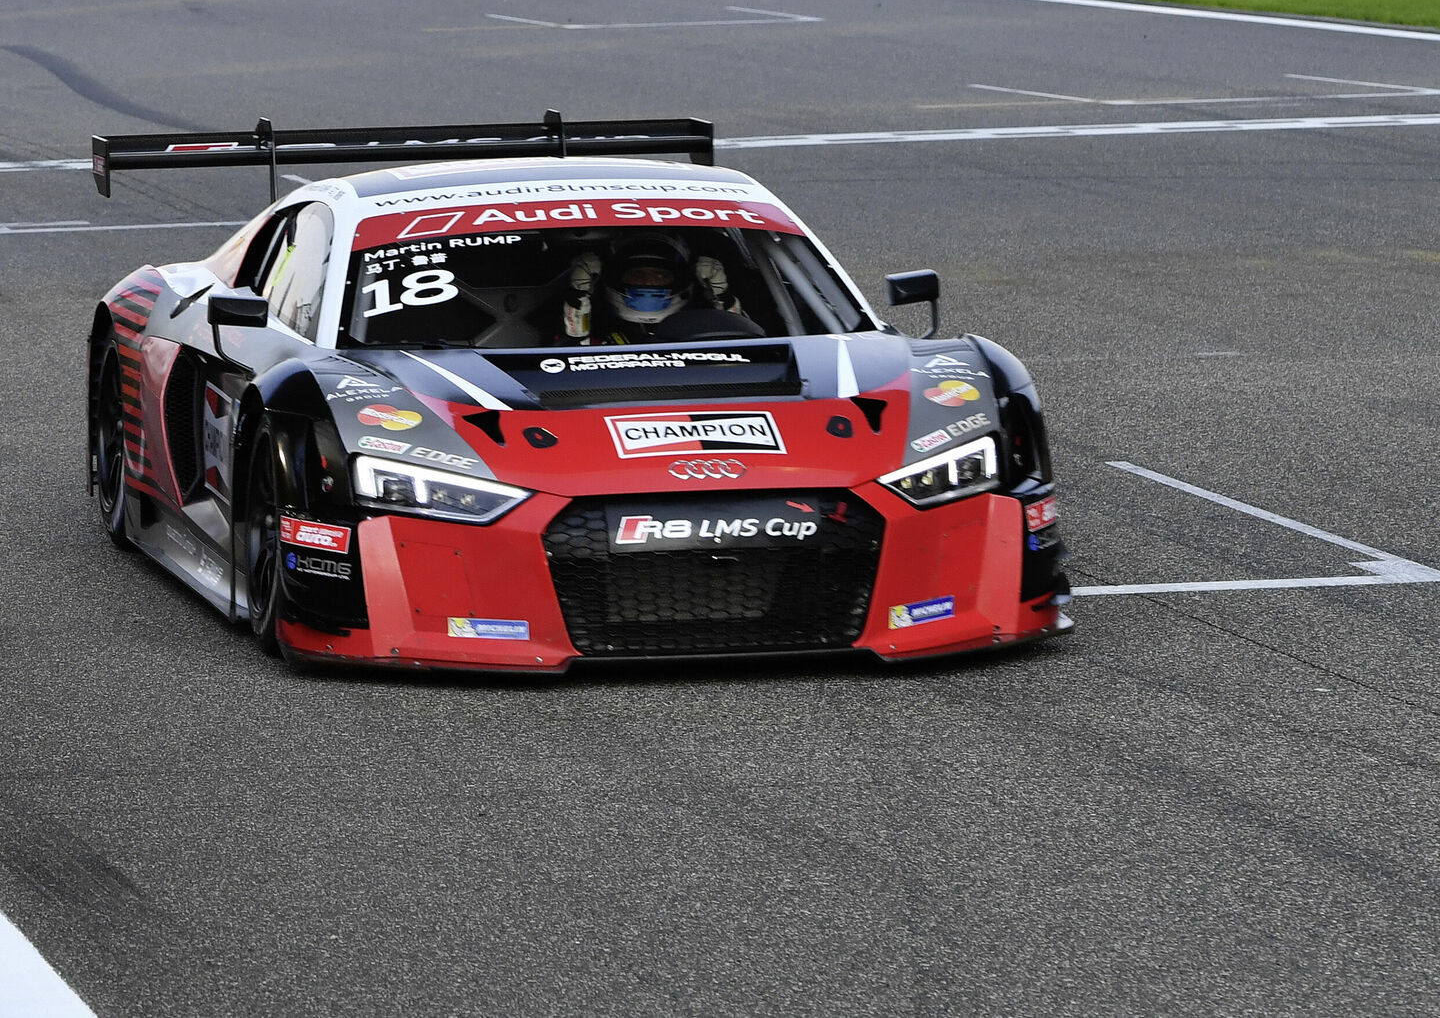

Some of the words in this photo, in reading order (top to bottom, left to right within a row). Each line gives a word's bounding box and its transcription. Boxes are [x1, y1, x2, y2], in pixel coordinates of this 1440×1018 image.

[374, 183, 749, 207] www.audir8lmscup.com
[472, 203, 598, 226] Audi
[610, 201, 765, 224] Sport
[363, 241, 443, 262] Martin
[448, 234, 523, 249] RUMP
[361, 268, 459, 318] 18
[567, 352, 751, 364] FEDERAL-MOGUL
[569, 359, 686, 372] MOTORPARTS
[326, 386, 404, 401] ALEXELA
[624, 423, 769, 441] CHAMPION
[945, 412, 992, 437] EDGE
[409, 446, 480, 470] EDGE
[698, 519, 760, 538] LMS
[765, 518, 818, 540] Cup
